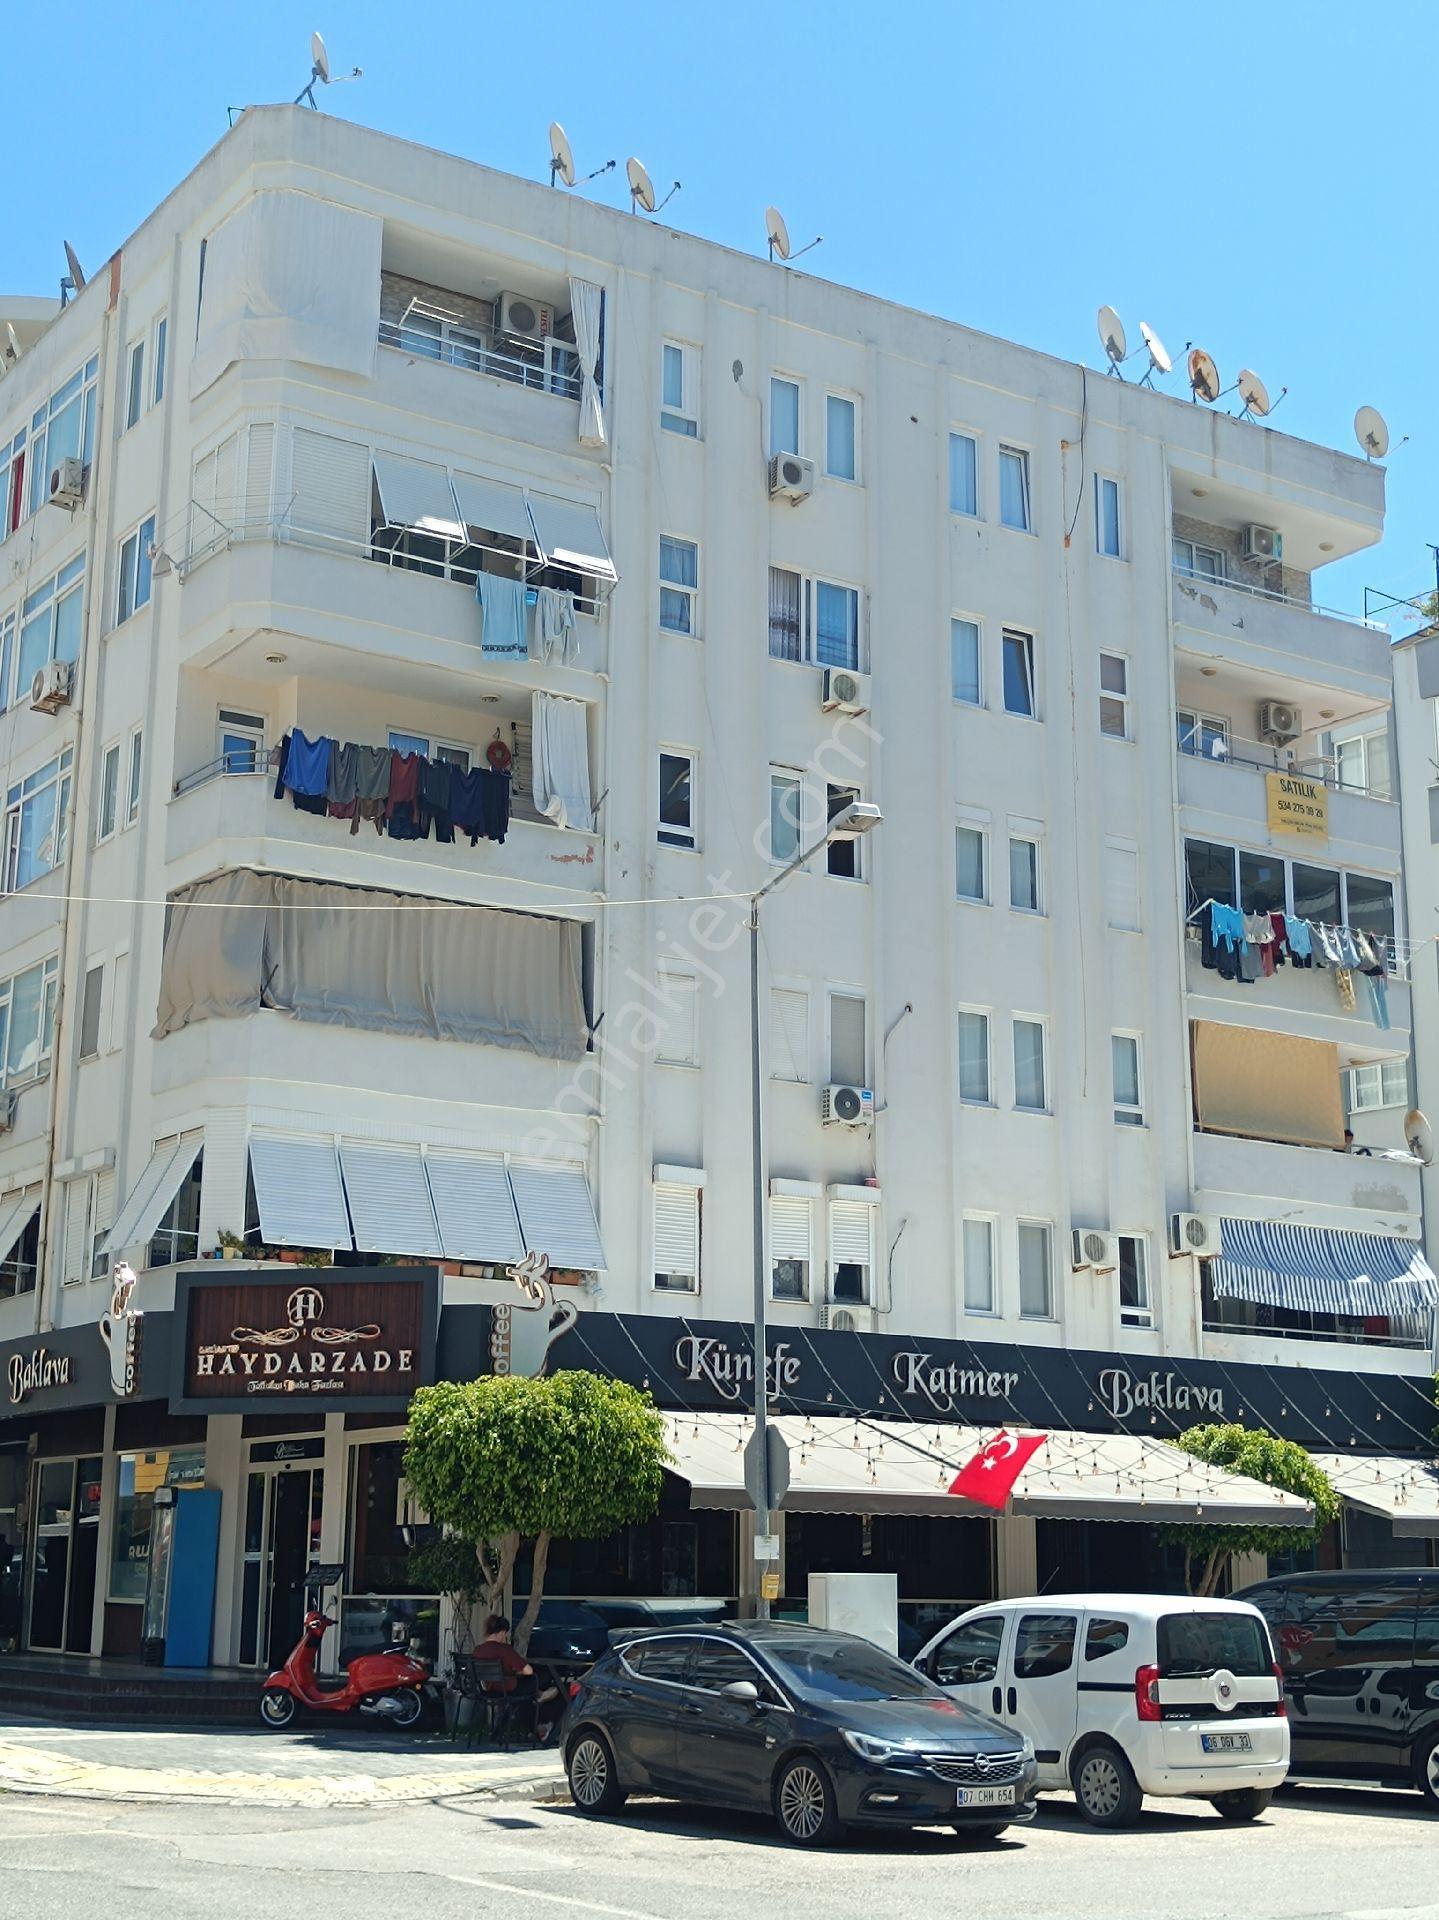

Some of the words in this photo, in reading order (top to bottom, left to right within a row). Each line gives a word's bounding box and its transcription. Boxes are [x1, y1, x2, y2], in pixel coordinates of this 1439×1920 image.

[1279, 778, 1317, 799] SATILIK
[196, 1350, 413, 1376] HAYDARZADE
[490, 1302, 511, 1376] offee
[8, 1348, 71, 1404] Baklava
[893, 1350, 1019, 1413] Katmer
[1099, 1368, 1224, 1418] Baklava
